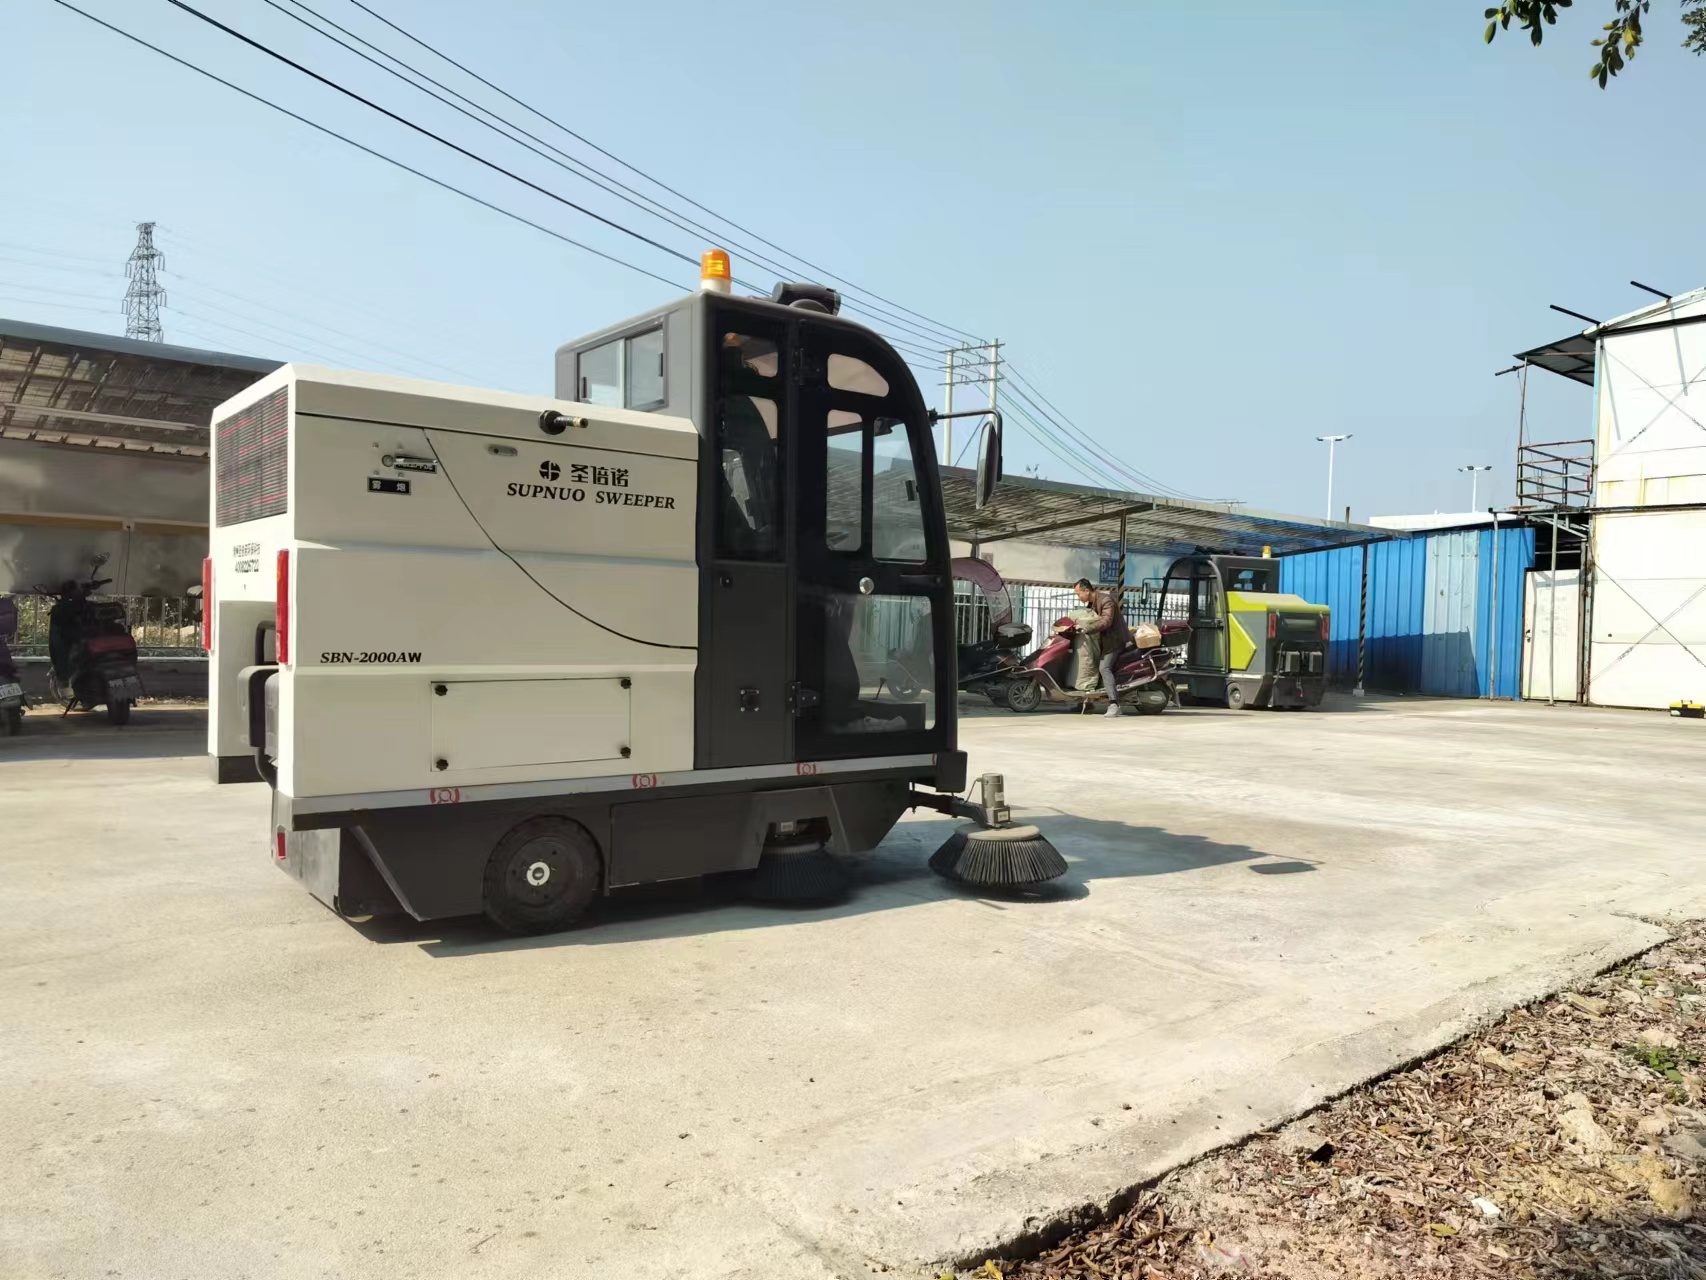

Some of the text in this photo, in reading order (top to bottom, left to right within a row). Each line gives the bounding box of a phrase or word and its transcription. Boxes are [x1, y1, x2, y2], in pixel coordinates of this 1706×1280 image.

[570, 463, 629, 487] 圣倍诺
[507, 482, 676, 510] SUPNUO SWEEPER
[320, 651, 422, 664] SBN-2000AW
